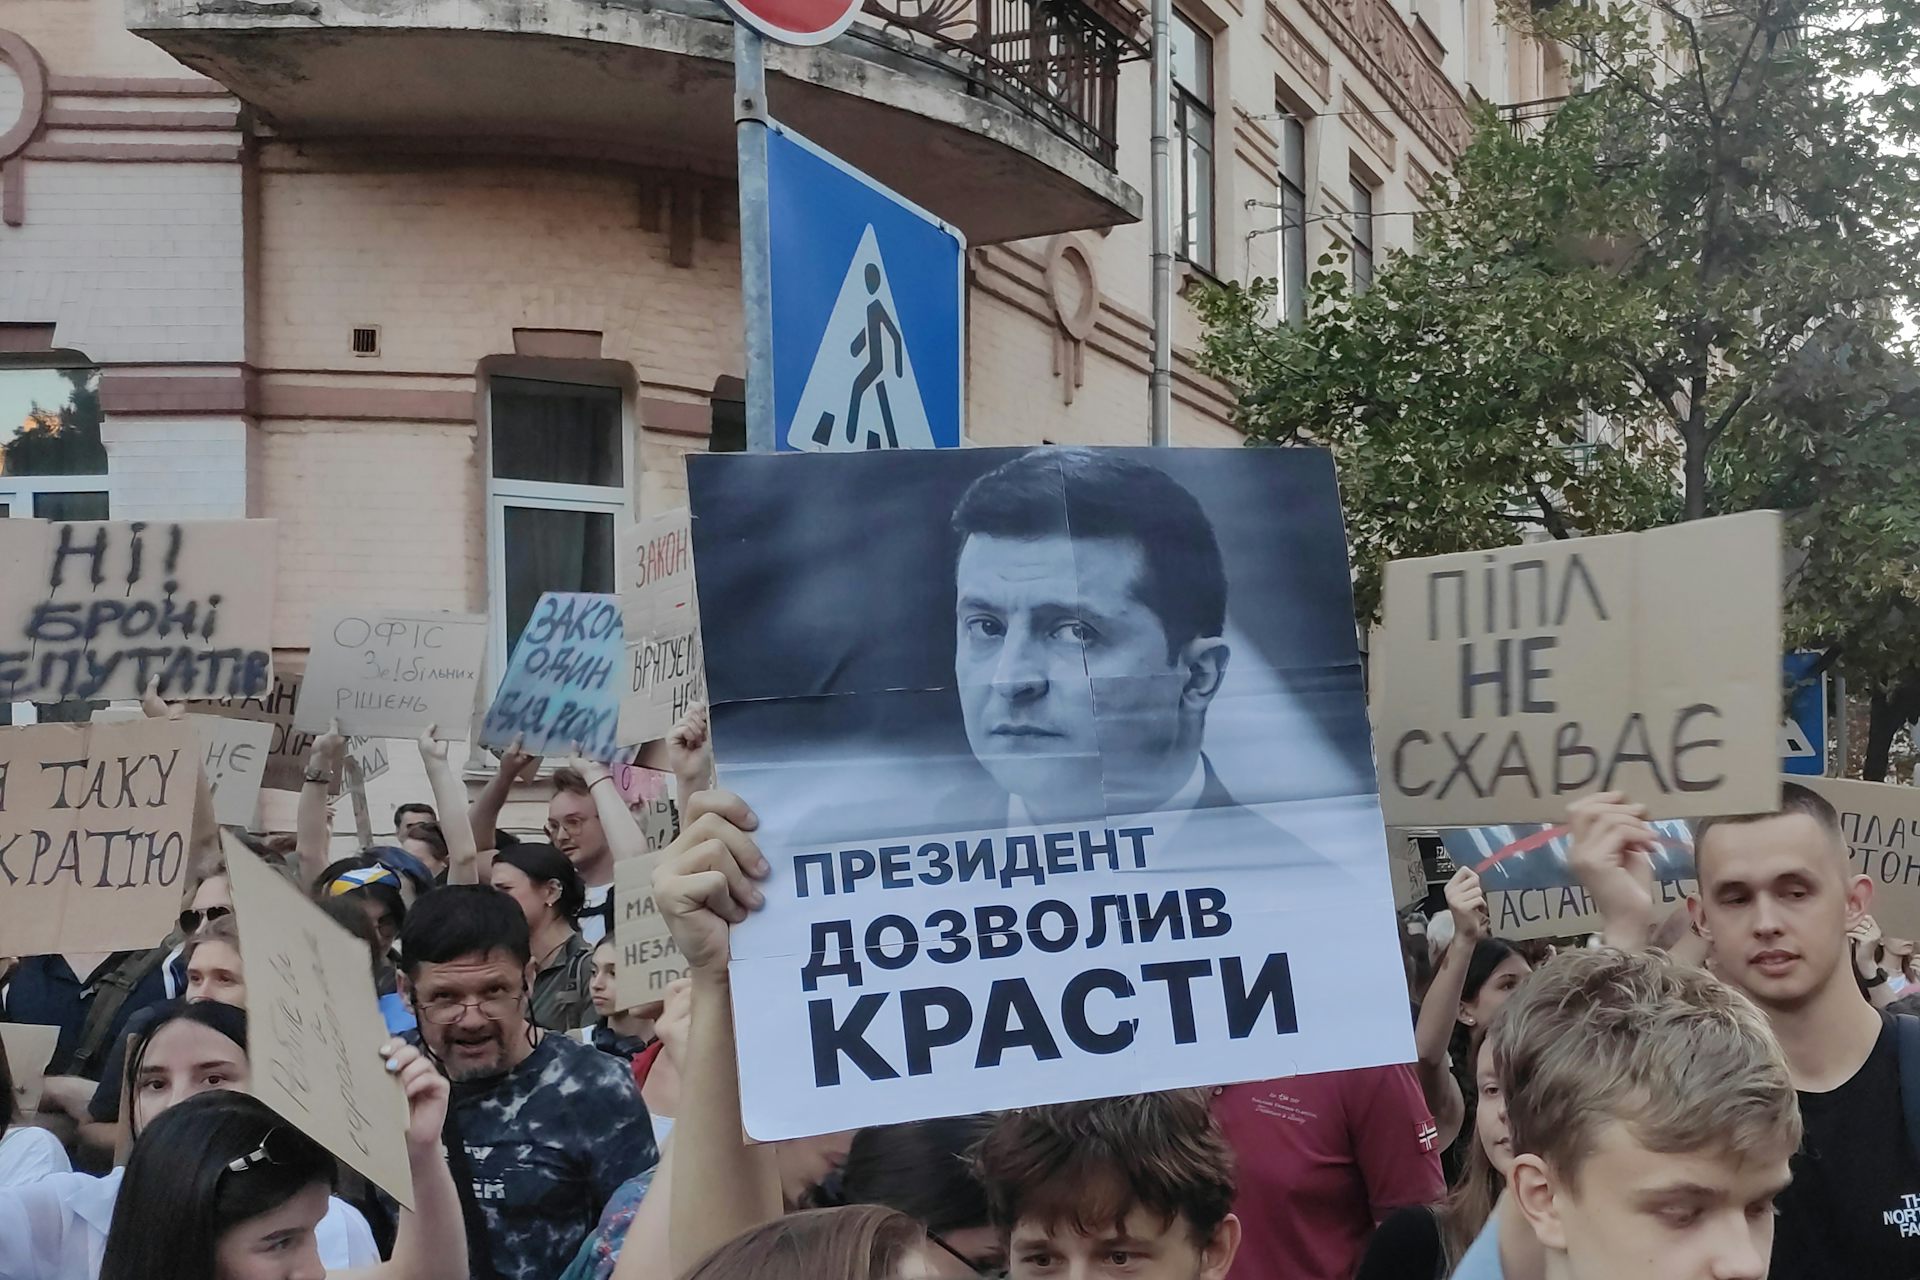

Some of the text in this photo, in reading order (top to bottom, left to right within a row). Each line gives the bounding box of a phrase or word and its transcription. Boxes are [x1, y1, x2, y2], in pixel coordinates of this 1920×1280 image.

[635, 527, 688, 589] ЗАКОН
[334, 617, 444, 649] ОФІС
[525, 646, 614, 691] ОДИН
[1458, 636, 1559, 719] НЕ
[40, 748, 182, 810] ТАКУ
[1392, 702, 1726, 800] СХАВАЄ
[793, 827, 1155, 898] ПРЕЗИДЕНТ
[626, 895, 655, 920] МА
[624, 935, 682, 967] НЕЗА
[801, 887, 1233, 992] ДОЗВОЛИВ
[807, 952, 1299, 1088] КРАСТИ
